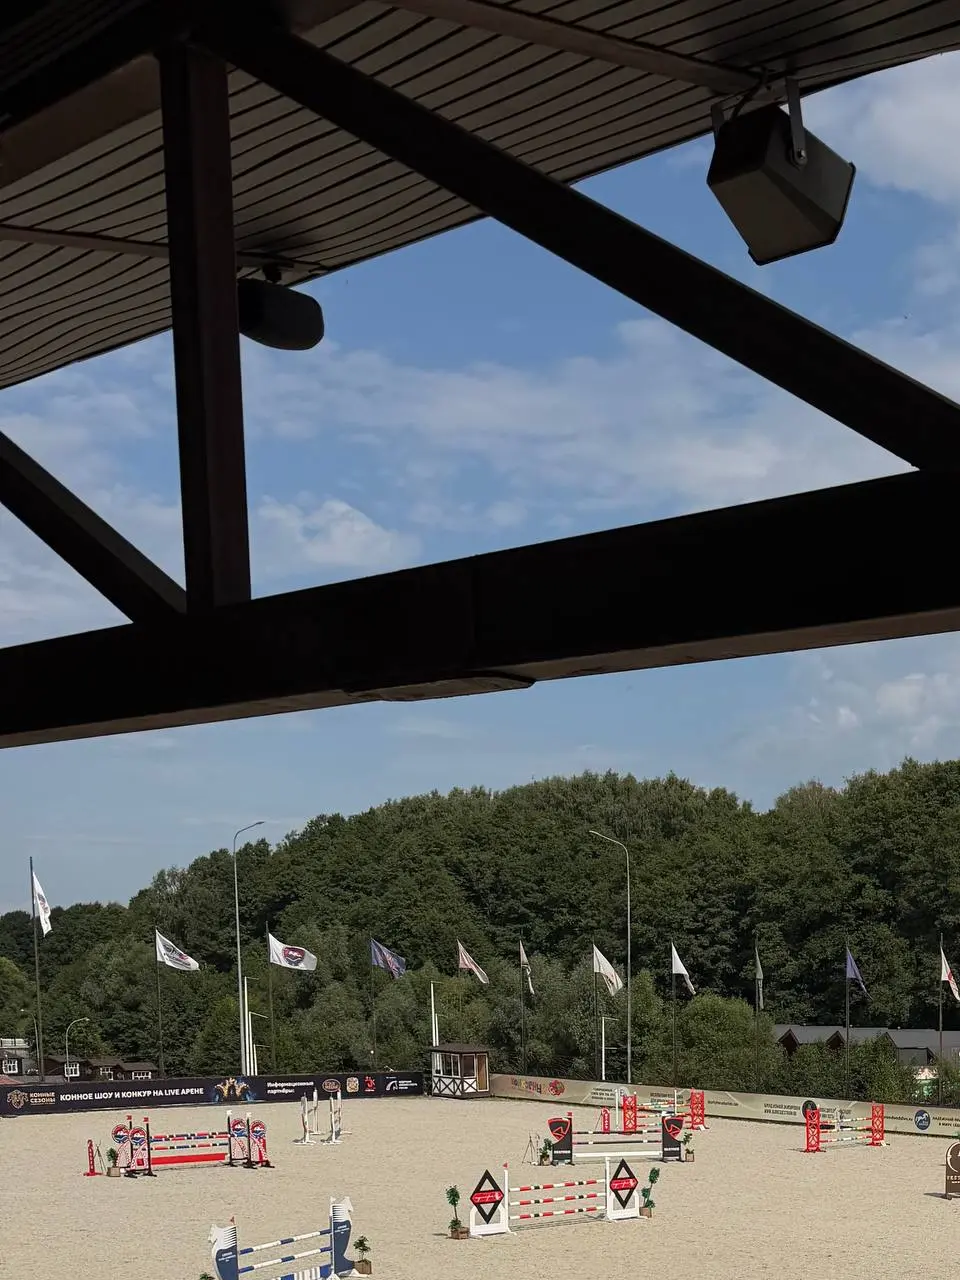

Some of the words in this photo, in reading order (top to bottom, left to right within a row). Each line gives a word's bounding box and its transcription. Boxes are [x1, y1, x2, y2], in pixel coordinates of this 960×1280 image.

[94, 1092, 113, 1100] ШОУ
[121, 1090, 152, 1099] КОНКУР
[153, 1089, 164, 1097] НА
[164, 1088, 180, 1096] LIVE
[181, 1087, 204, 1095] АРЕНЕ
